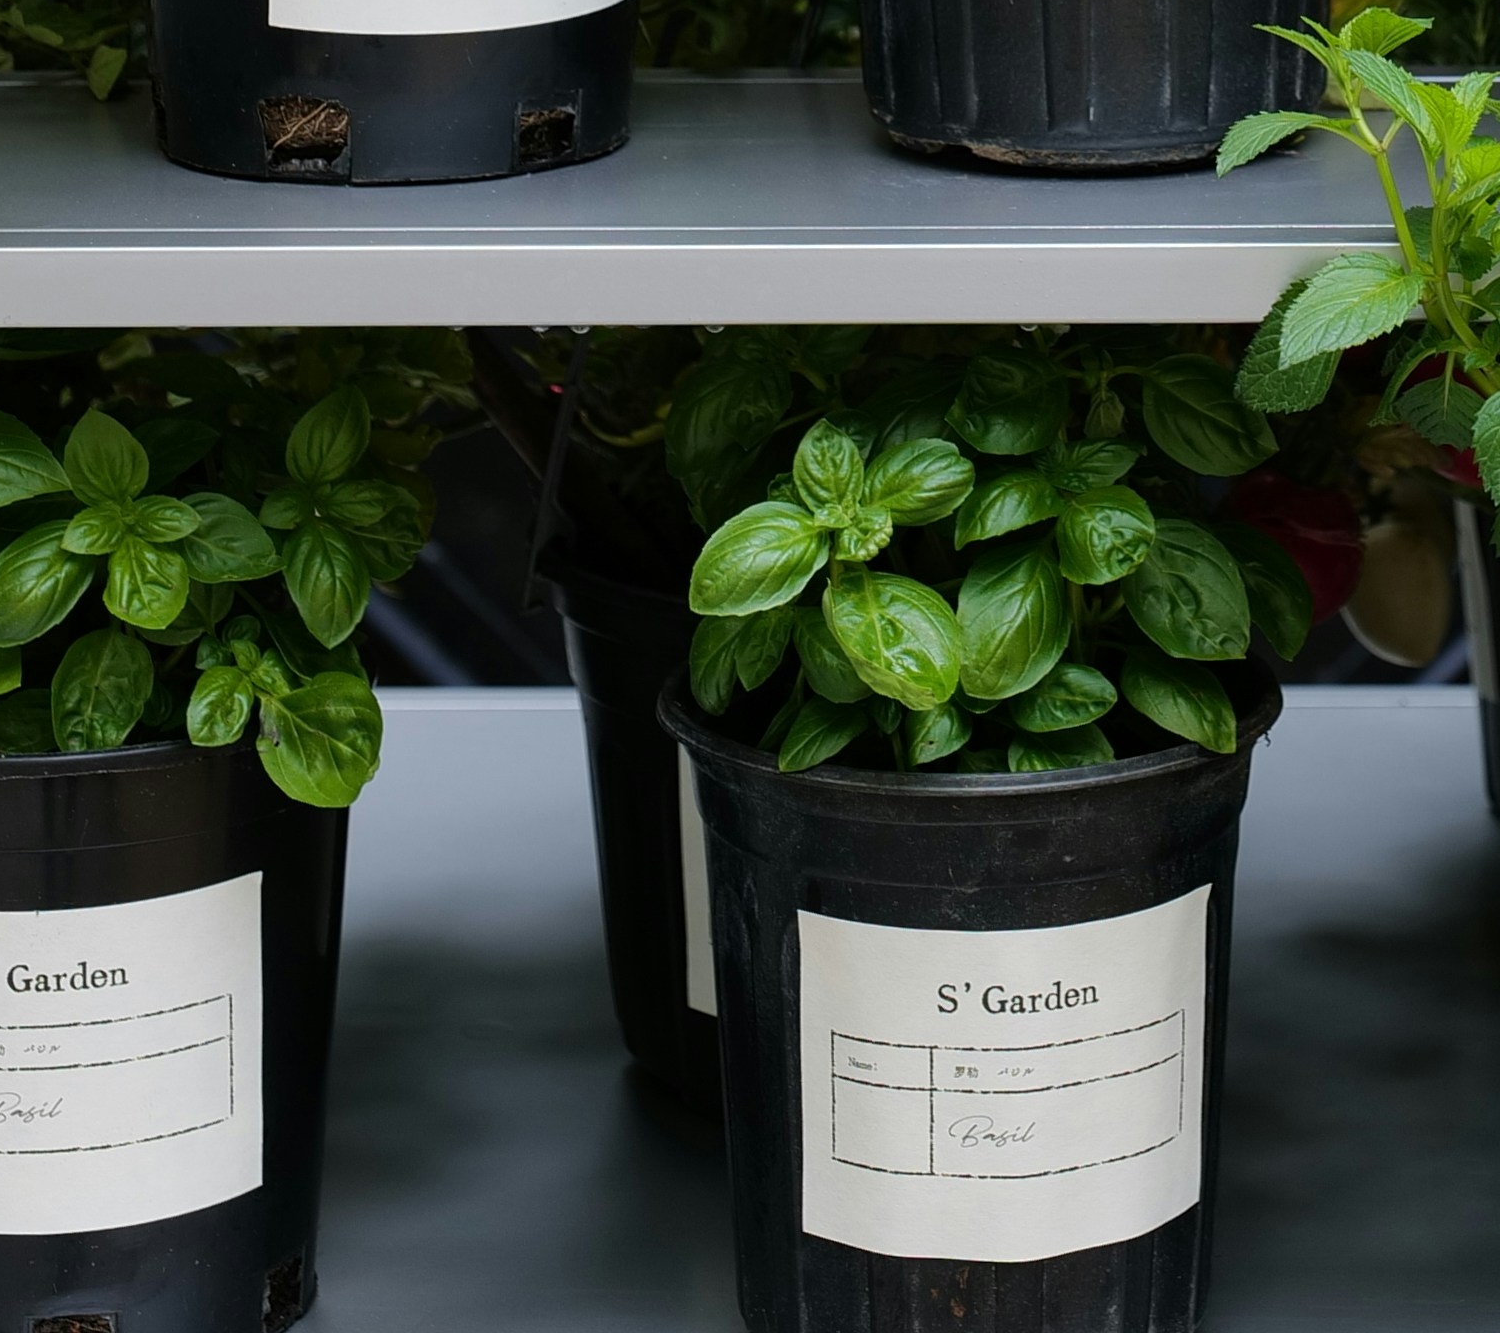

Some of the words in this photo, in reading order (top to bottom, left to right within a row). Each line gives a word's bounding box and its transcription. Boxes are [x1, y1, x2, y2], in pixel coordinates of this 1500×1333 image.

[6, 960, 130, 994] Garden
[936, 981, 972, 1014] S'
[981, 980, 1100, 1015] Garden
[847, 1055, 878, 1072] Name:
[947, 1114, 1036, 1149] Basil
